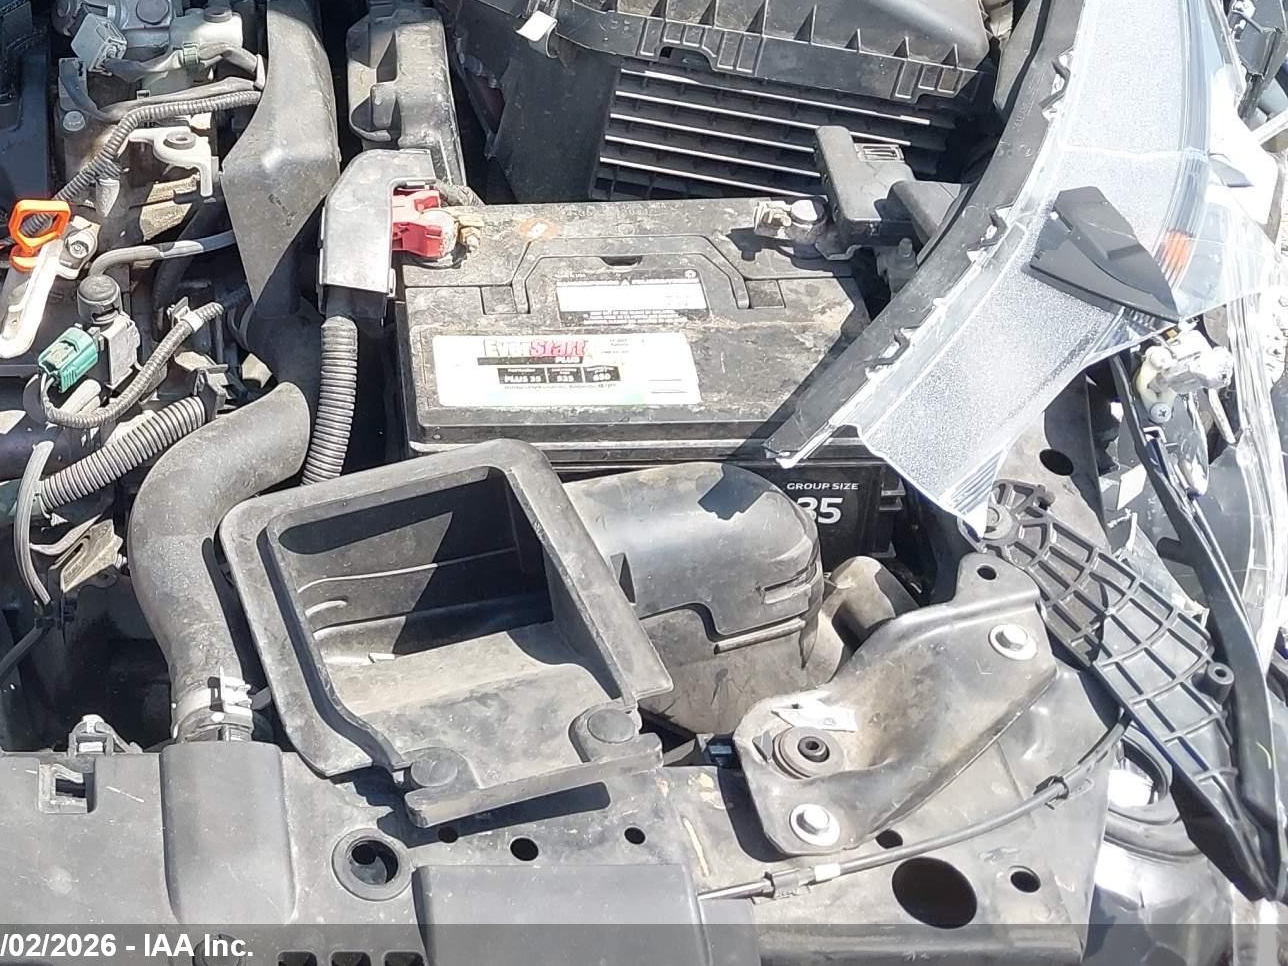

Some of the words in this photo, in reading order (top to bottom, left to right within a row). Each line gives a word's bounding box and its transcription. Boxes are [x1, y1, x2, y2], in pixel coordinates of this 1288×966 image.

[555, 356, 581, 364] PLUS
[504, 374, 528, 383] PLUS
[786, 482, 829, 490] GROUP
[831, 482, 859, 490] SIZE
